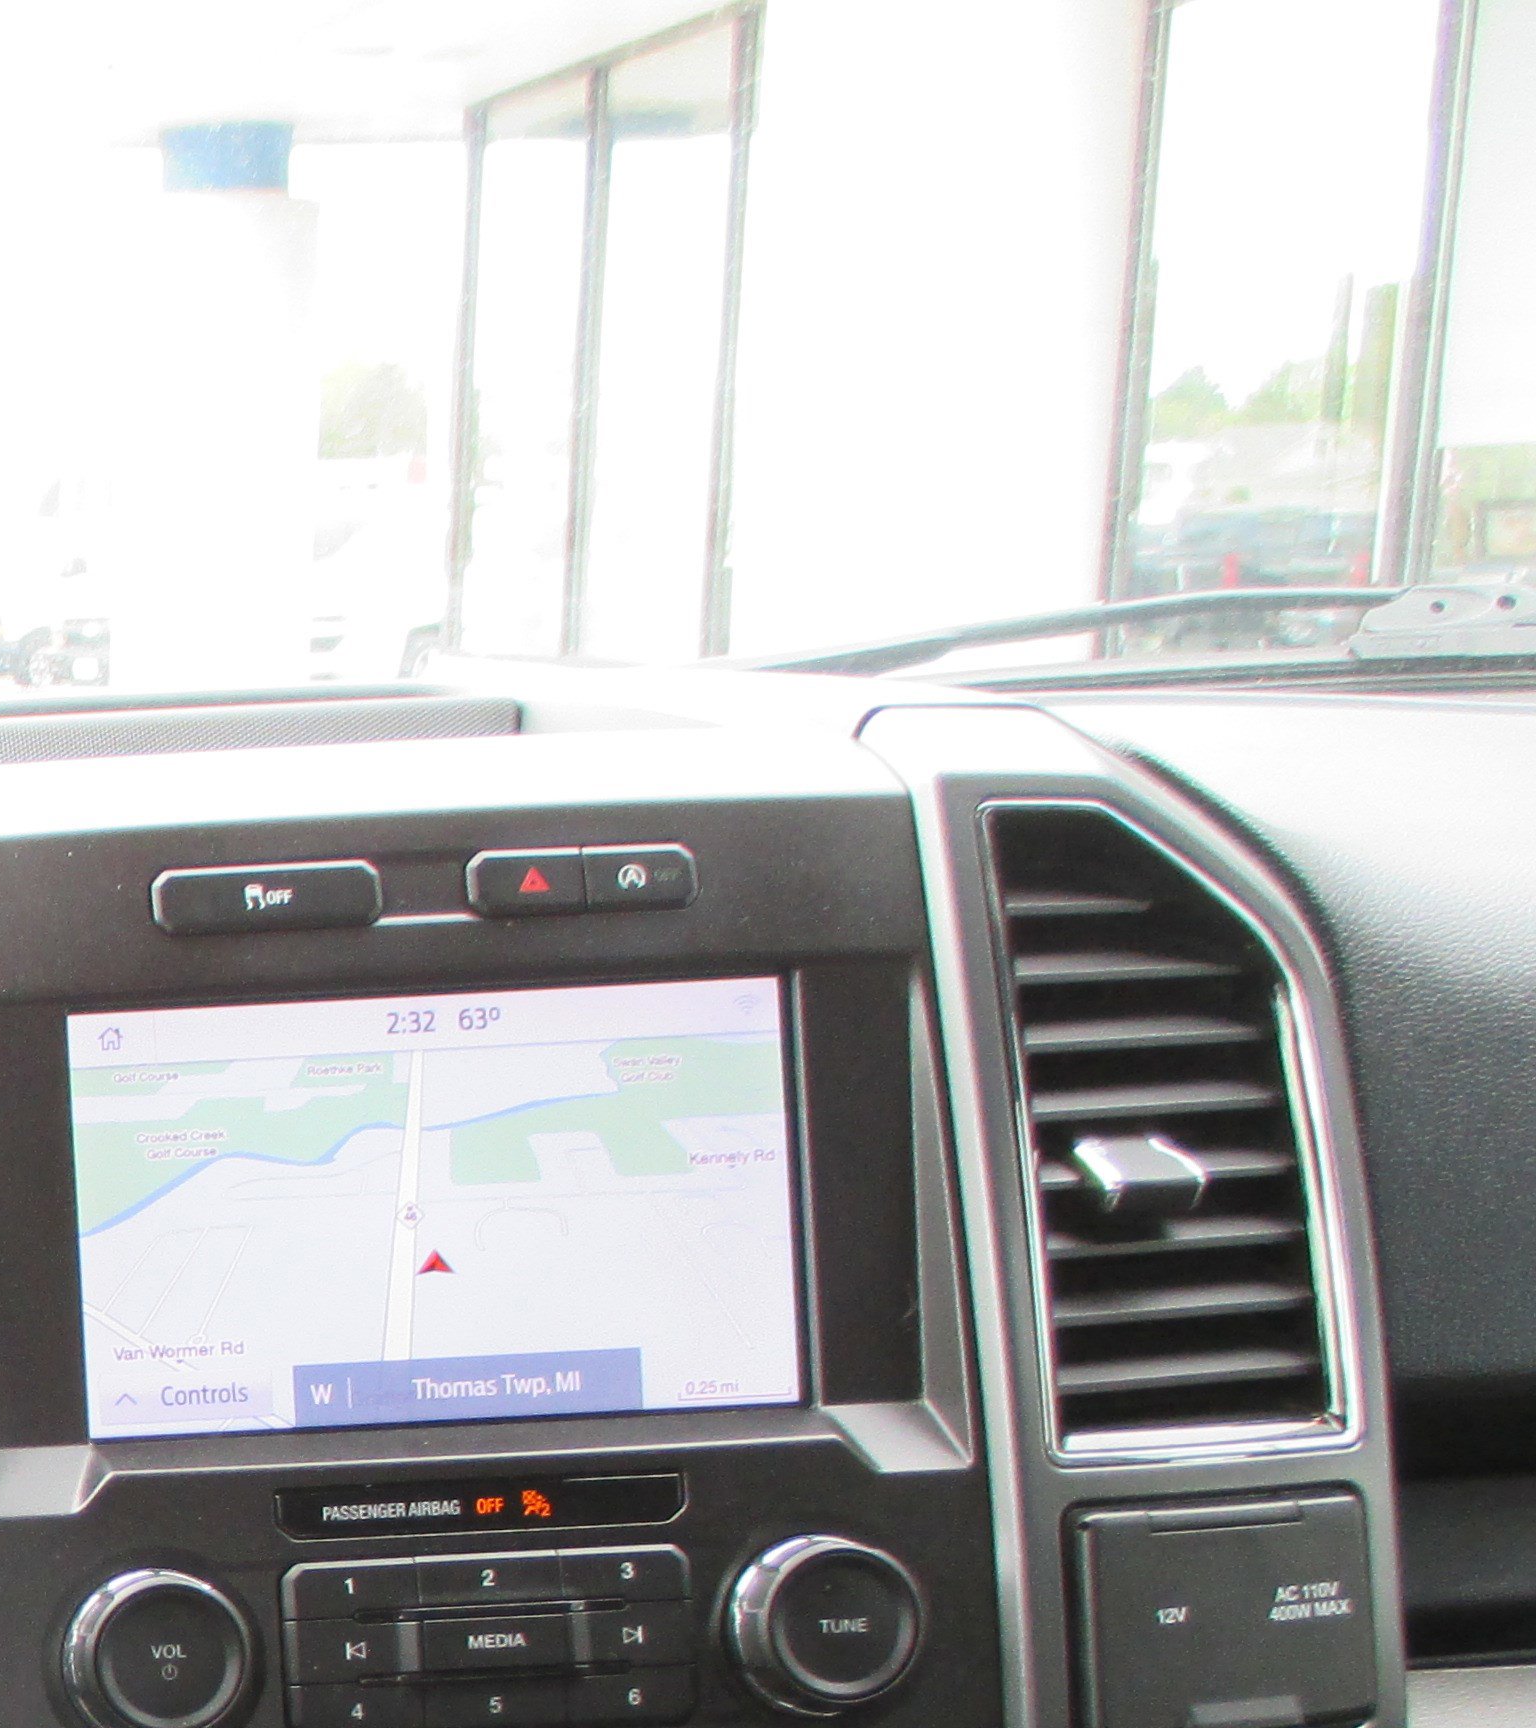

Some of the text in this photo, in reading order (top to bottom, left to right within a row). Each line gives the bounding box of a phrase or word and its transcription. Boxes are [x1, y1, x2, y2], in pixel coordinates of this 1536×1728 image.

[266, 888, 294, 906] OFF
[386, 1011, 437, 1035] 2:32
[113, 1070, 180, 1084] Golf Course
[357, 1062, 382, 1074] Park
[136, 1129, 225, 1144] Crooked Creek
[146, 1146, 217, 1161] Golf Course
[755, 1148, 776, 1162] Rd
[114, 1341, 245, 1361] Van Wormer Rd
[160, 1381, 249, 1406] Controls
[310, 1383, 333, 1405] W
[411, 1371, 581, 1400] Thomas Twp, MI
[684, 1379, 740, 1396] 0.25 mi
[323, 1497, 505, 1522] PASSENGER AIRBAG OFF
[481, 1568, 496, 1587] 2
[620, 1562, 635, 1580] 3
[343, 1577, 355, 1595] 1
[1275, 1584, 1300, 1602] AC
[1157, 1605, 1190, 1624] 12V
[1314, 1598, 1355, 1617] MAX
[819, 1617, 871, 1635] TUNE
[467, 1632, 528, 1651] MEDIA
[150, 1643, 187, 1661] VOL
[488, 1695, 504, 1715] 5
[628, 1688, 643, 1706] 6
[350, 1702, 365, 1721] 4
